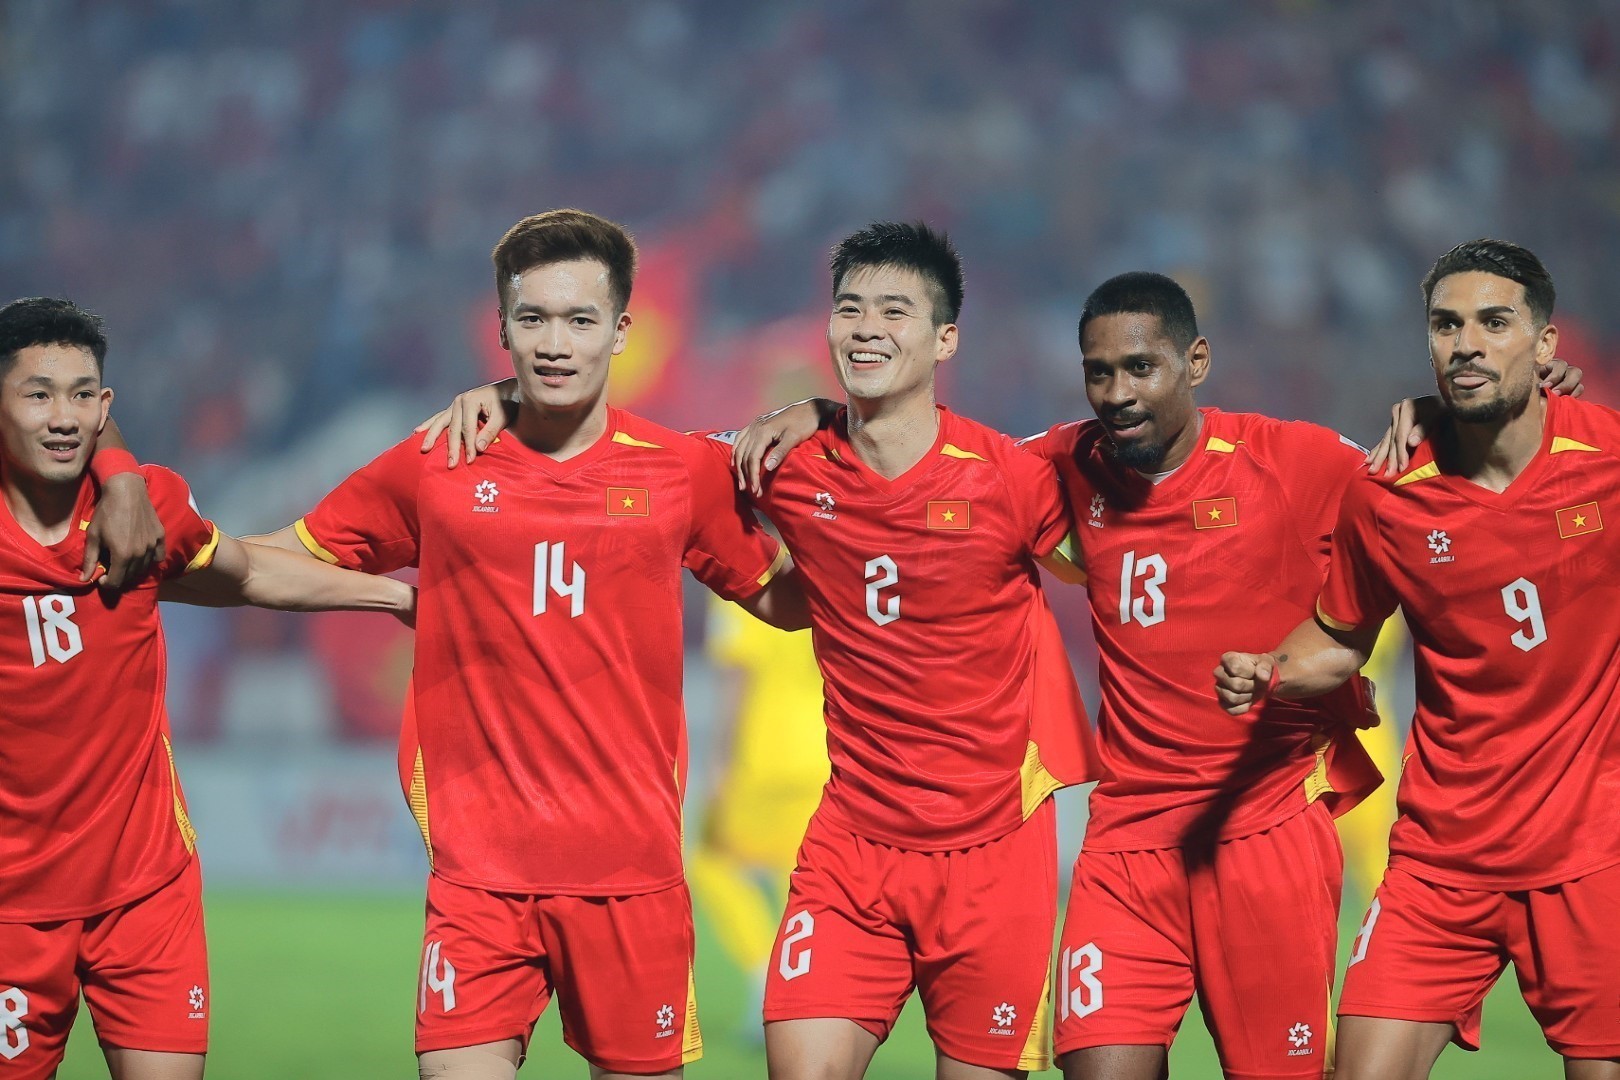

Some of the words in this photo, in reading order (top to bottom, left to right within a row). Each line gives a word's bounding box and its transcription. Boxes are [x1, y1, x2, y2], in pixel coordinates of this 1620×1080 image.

[532, 540, 586, 619] 14
[864, 554, 901, 627] 2
[1119, 550, 1168, 628] 13
[1500, 576, 1548, 653] 9
[22, 594, 84, 669] 18
[778, 909, 815, 982] 2
[1349, 896, 1381, 969] 9
[419, 940, 456, 1015] 14
[1061, 941, 1104, 1023] 13
